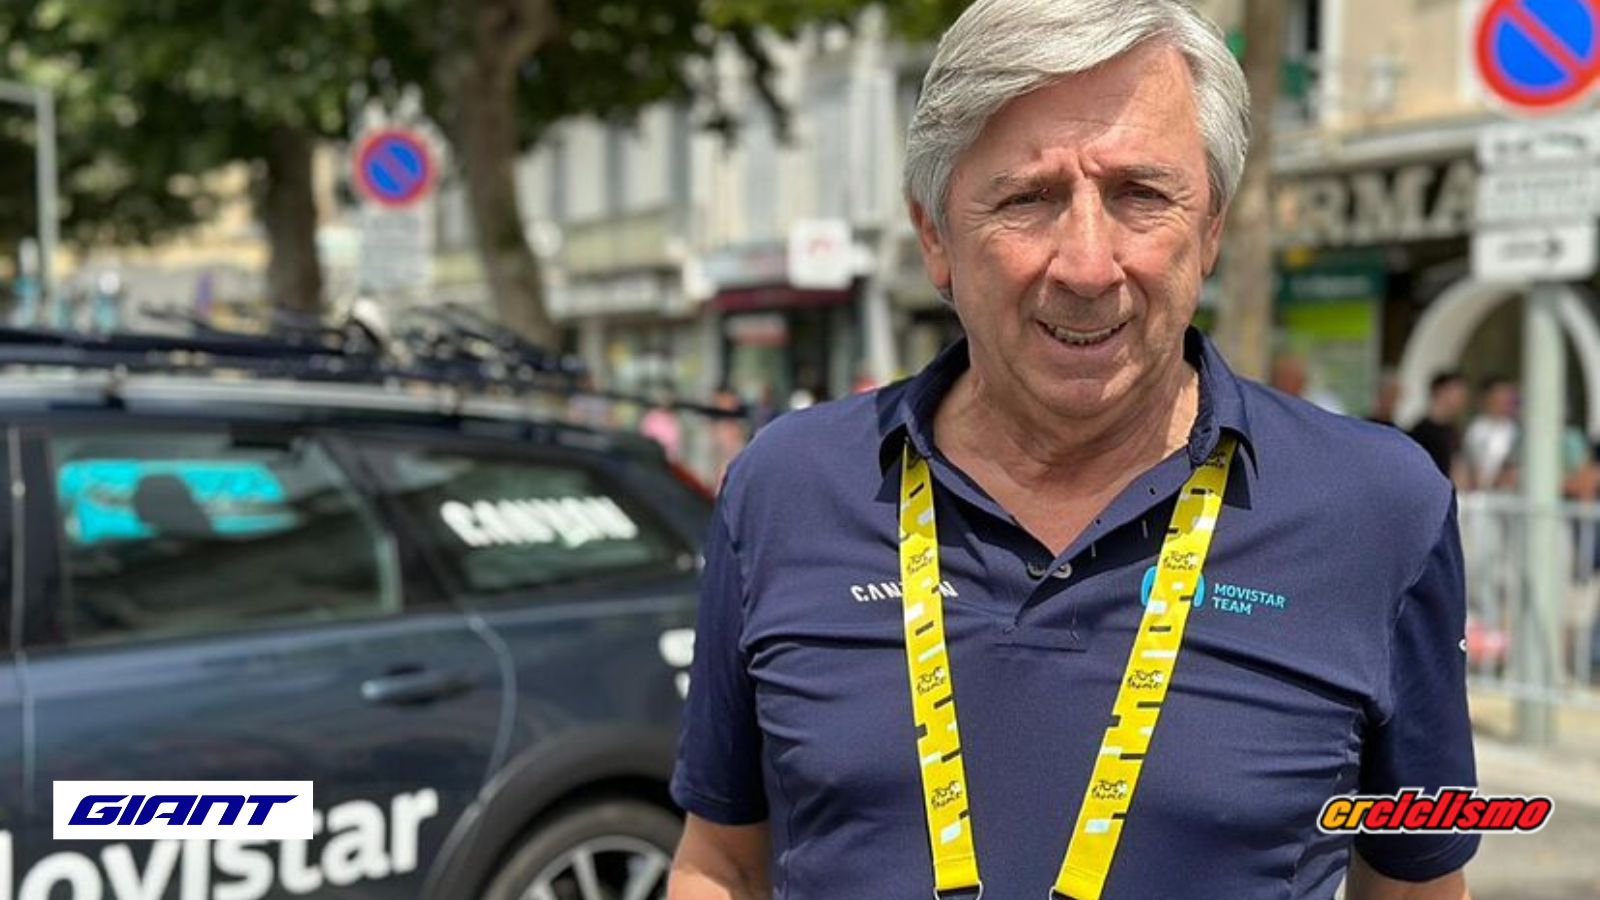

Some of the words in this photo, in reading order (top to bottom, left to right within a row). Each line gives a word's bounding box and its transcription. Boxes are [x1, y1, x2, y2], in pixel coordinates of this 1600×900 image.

[850, 580, 959, 602] CANN
[1213, 583, 1287, 609] MOVISTAR
[1212, 596, 1252, 616] TEAM
